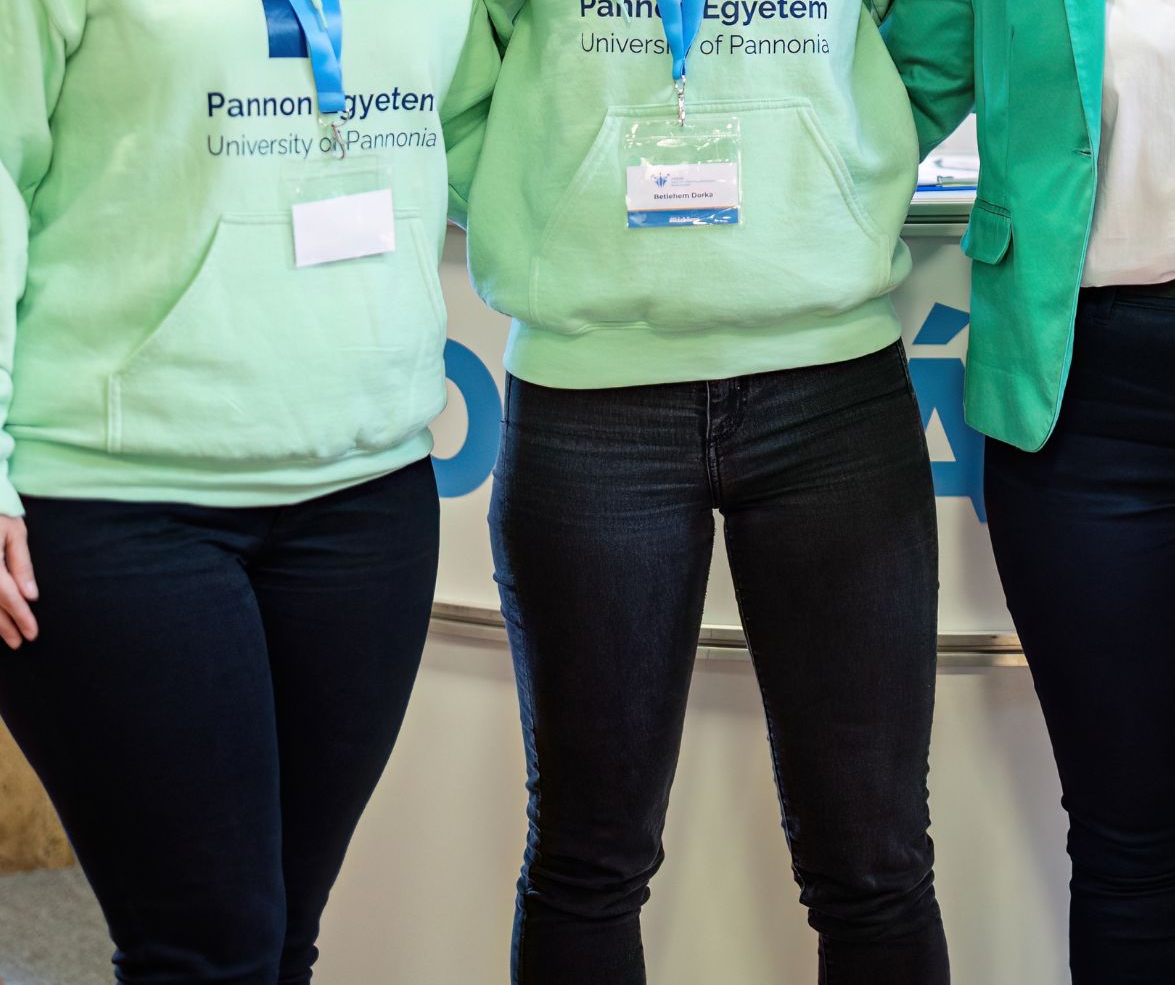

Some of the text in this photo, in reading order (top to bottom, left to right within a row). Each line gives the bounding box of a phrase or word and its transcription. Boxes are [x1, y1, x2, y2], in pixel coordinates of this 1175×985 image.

[699, 34, 724, 55] of
[729, 33, 829, 55] Pannonia
[207, 91, 313, 118] Pannon
[207, 133, 313, 160] University
[346, 127, 437, 151] Pannonia
[653, 191, 714, 200] Betlehem Dorka
